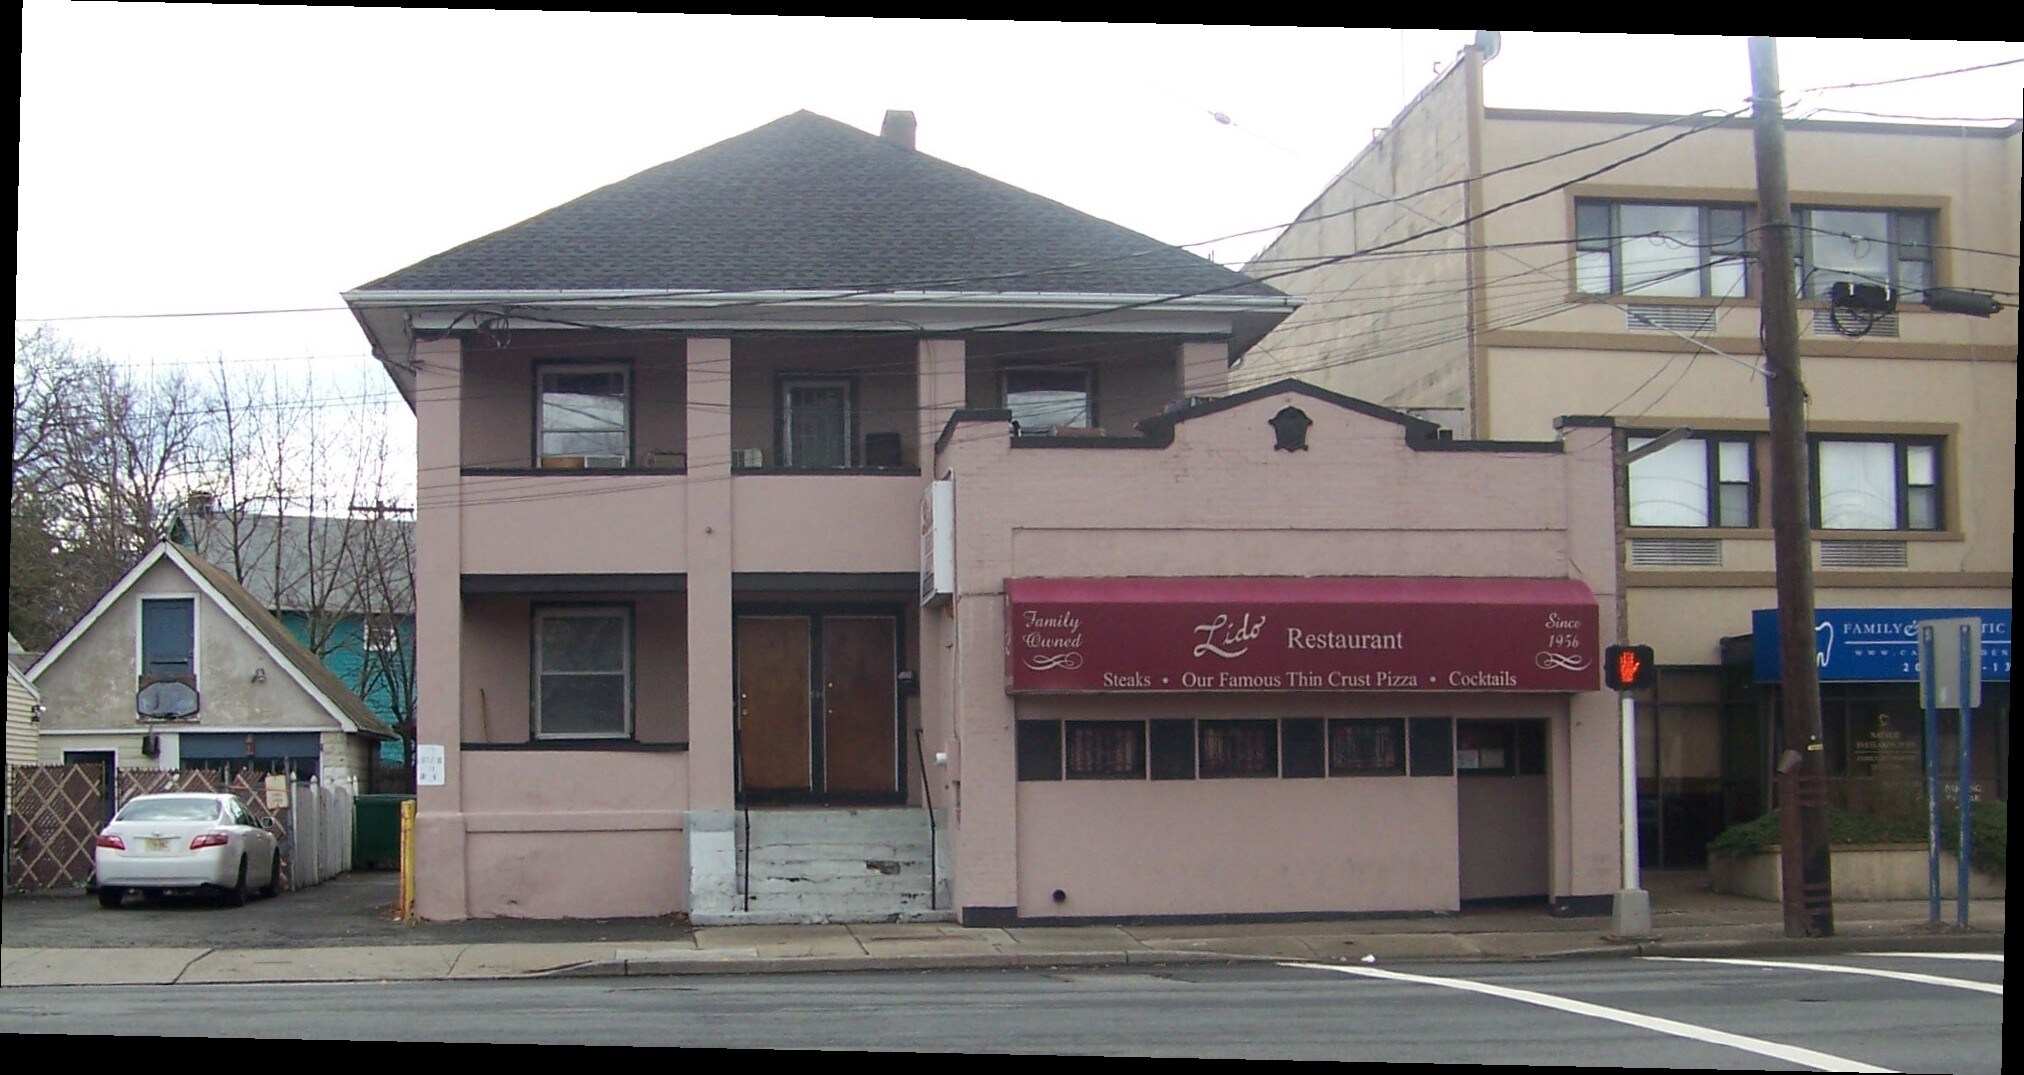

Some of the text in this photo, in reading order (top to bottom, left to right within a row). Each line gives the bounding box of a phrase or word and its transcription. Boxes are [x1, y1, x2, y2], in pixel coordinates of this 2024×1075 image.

[1022, 610, 1081, 633] Family
[1545, 612, 1582, 630] Since
[1843, 623, 1903, 634] FAMILY
[1022, 632, 1083, 648] Owned
[1193, 612, 1403, 658] Lido Restaurant
[1548, 634, 1580, 648] 1956
[1103, 670, 1517, 687] Steaks Our Famous Thin Crust Pizza Cocktails
